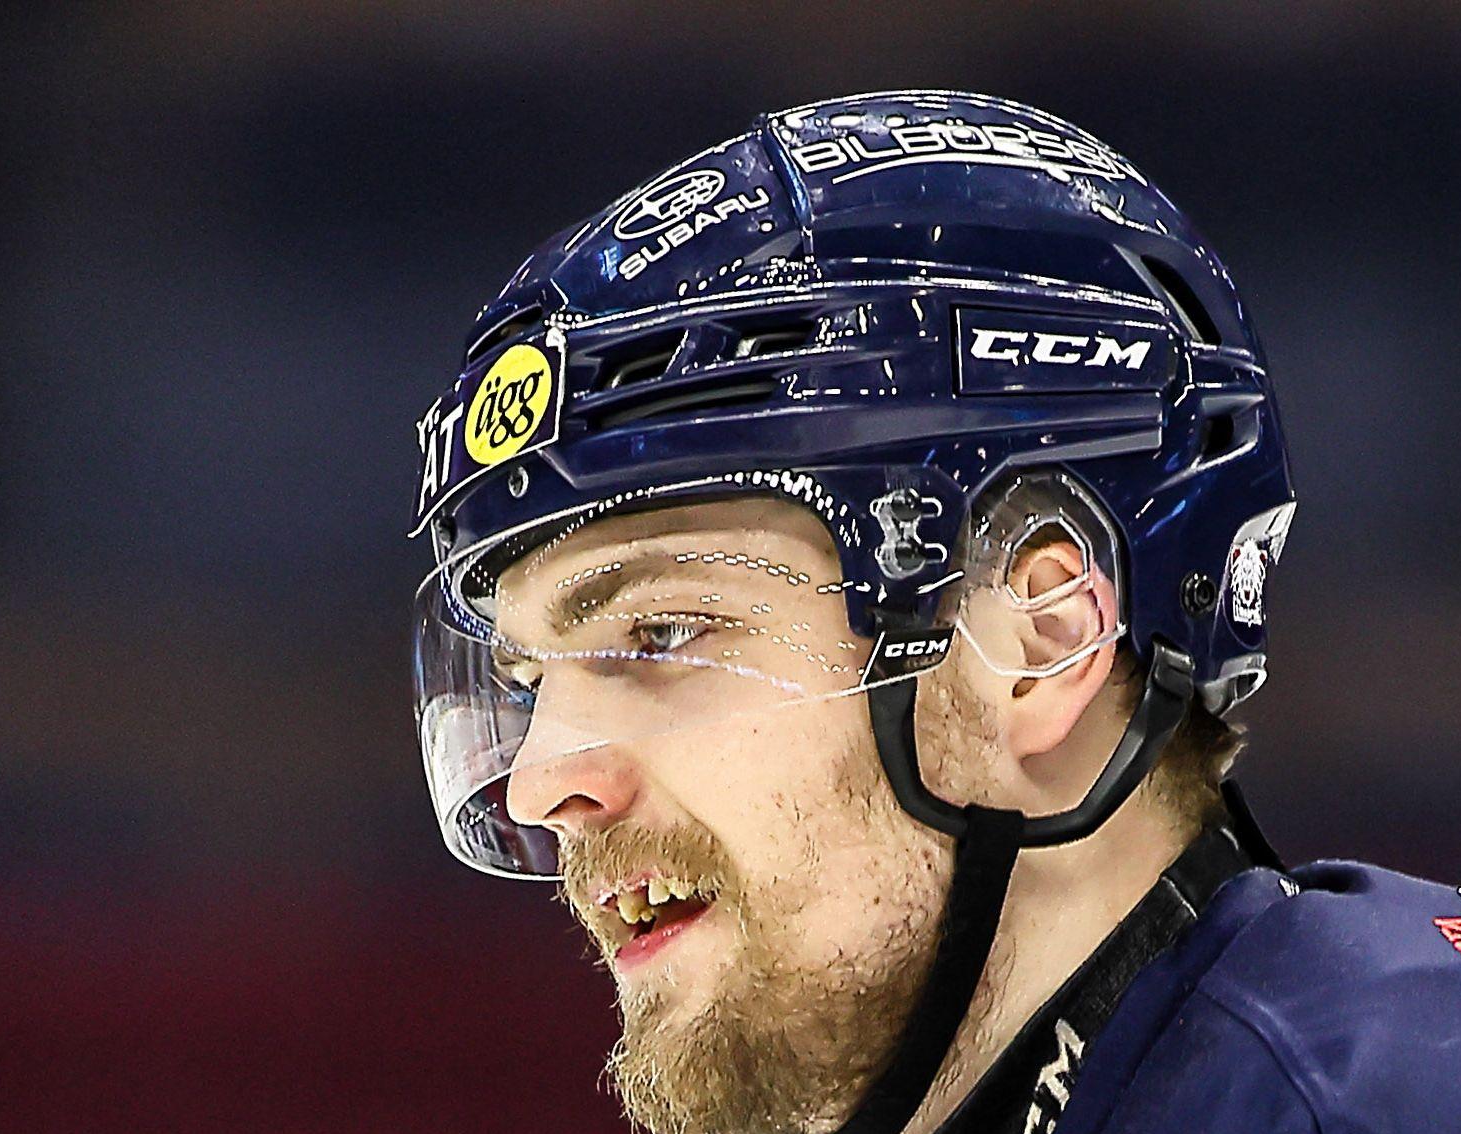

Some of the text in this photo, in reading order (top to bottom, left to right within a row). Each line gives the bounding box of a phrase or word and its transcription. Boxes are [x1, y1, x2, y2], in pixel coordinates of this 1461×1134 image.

[618, 188, 770, 281] SUBARU
[970, 327, 1151, 370] CCM
[474, 367, 545, 448] ägg
[884, 638, 949, 658] CCM
